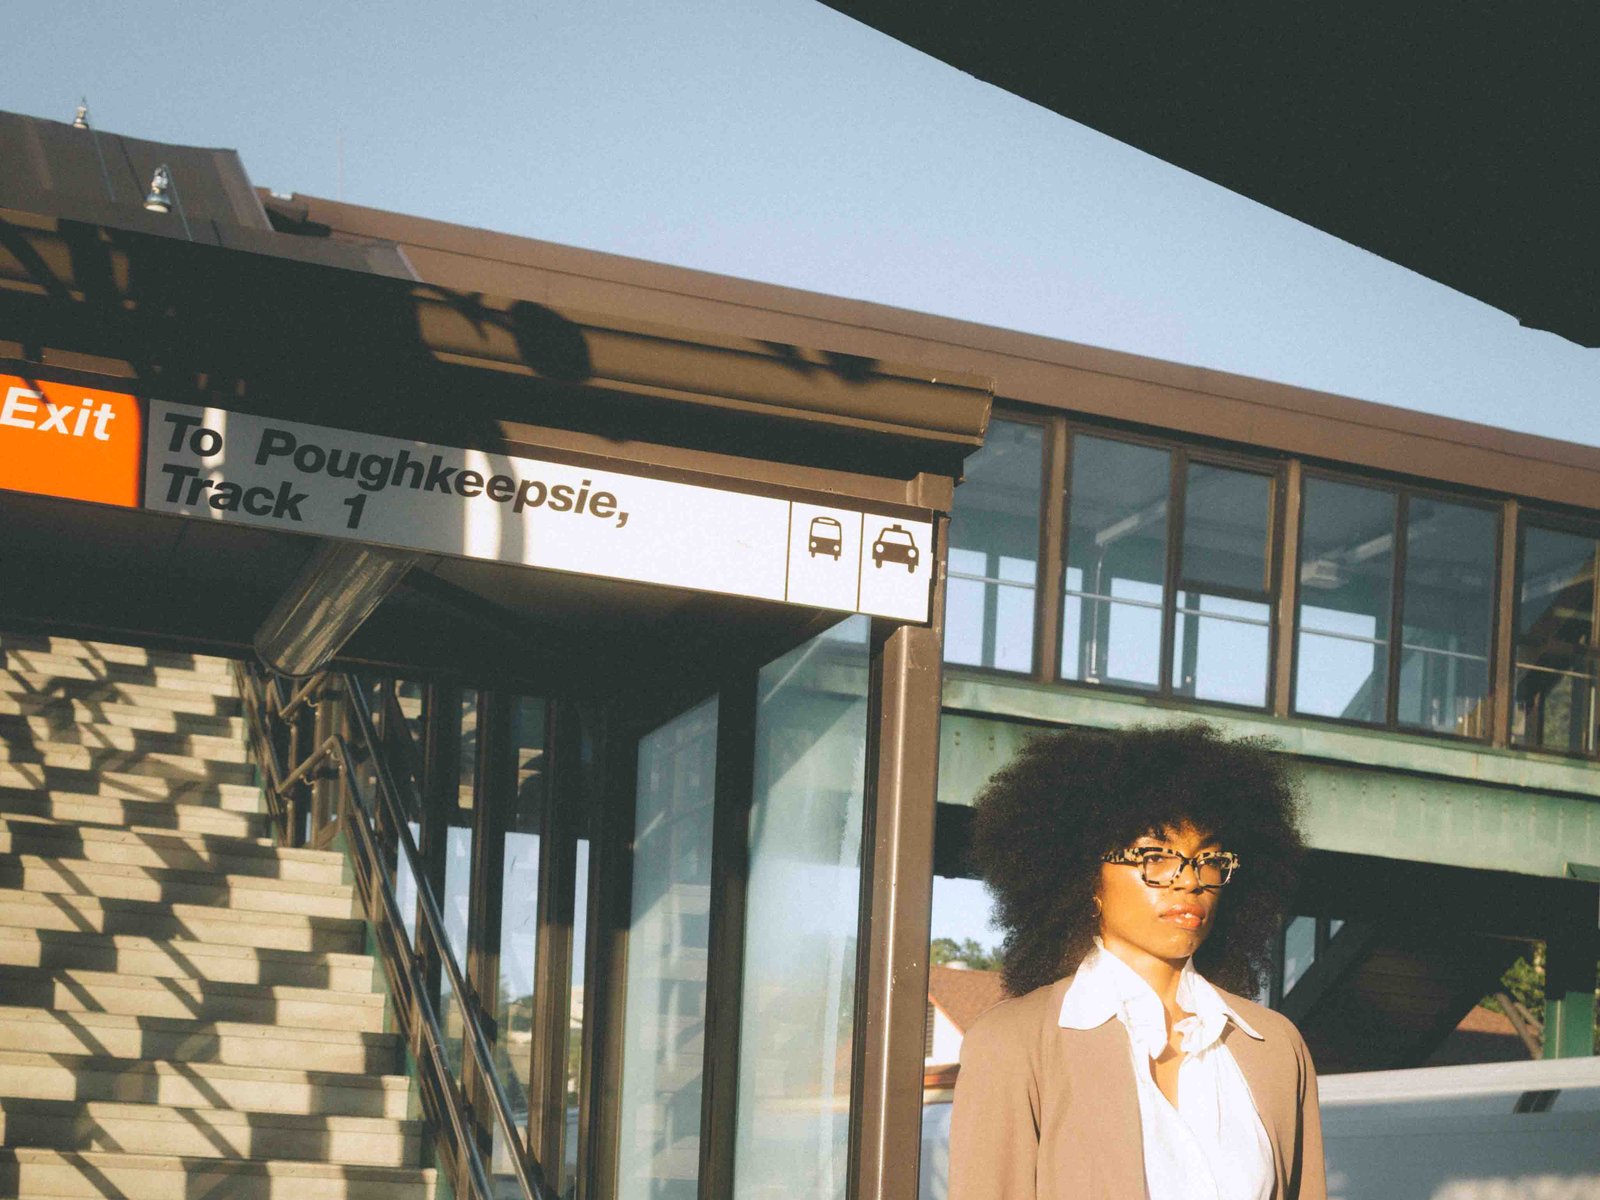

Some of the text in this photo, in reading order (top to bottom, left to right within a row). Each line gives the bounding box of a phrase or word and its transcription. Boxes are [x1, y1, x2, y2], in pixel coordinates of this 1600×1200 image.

[0, 386, 116, 441] Exit
[162, 463, 367, 529] Track 1
[164, 412, 630, 529] To Poughkeepsie,
